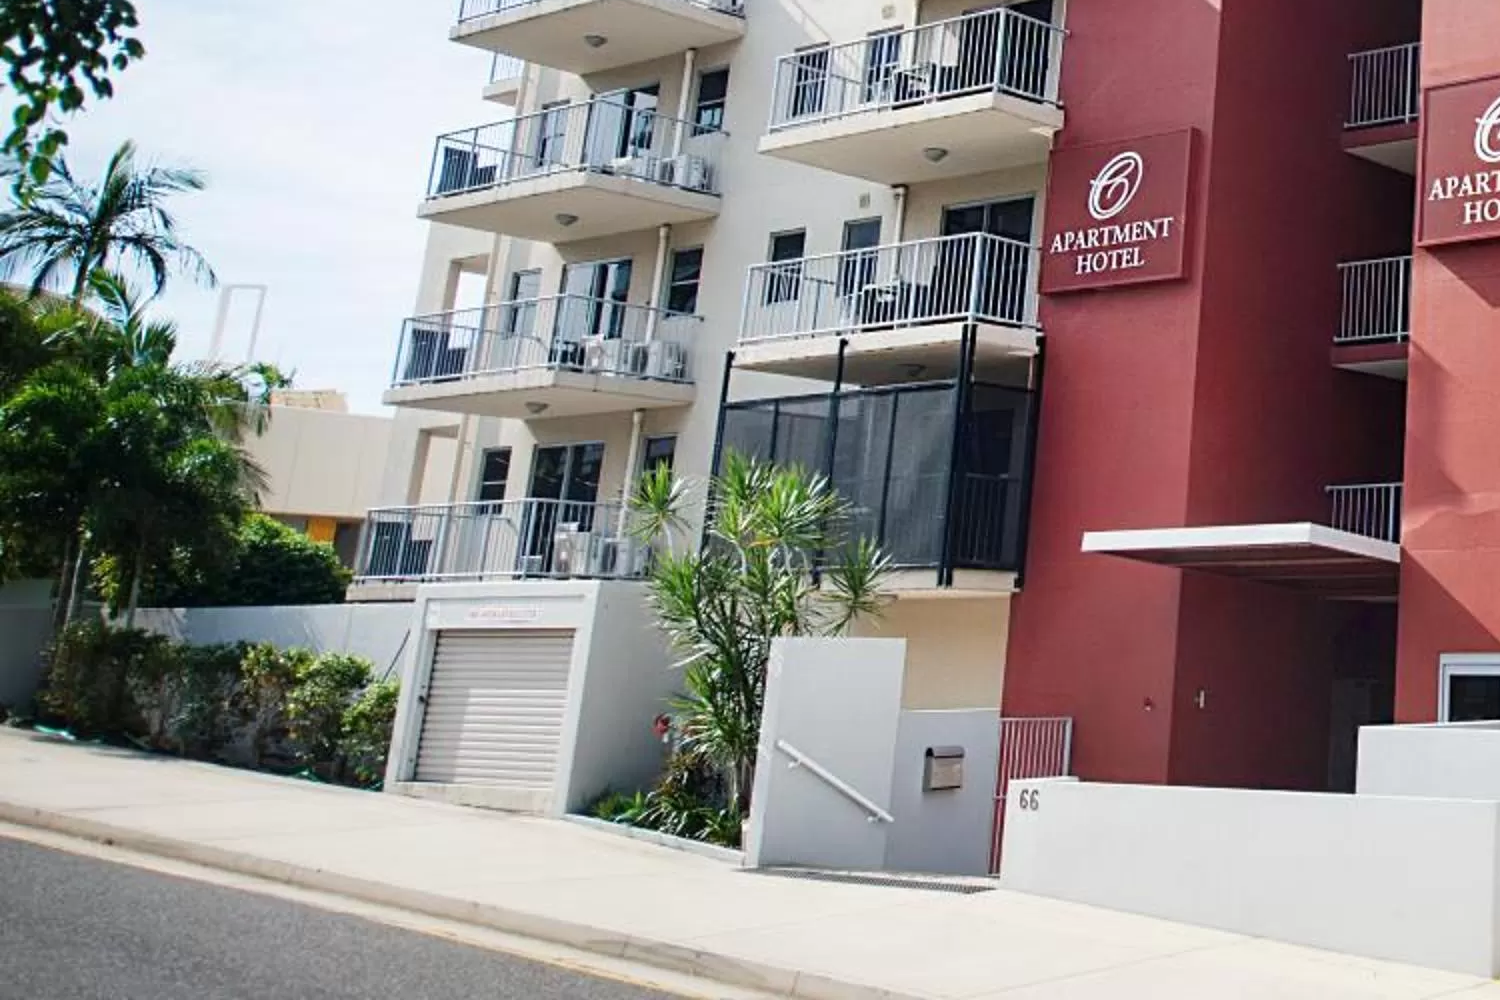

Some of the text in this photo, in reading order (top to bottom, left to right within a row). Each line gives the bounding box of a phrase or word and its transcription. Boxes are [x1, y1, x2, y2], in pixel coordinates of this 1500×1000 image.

[1050, 217, 1174, 254] APARTMENT
[1075, 248, 1145, 275] HOTEL
[1019, 789, 1039, 811] 66
